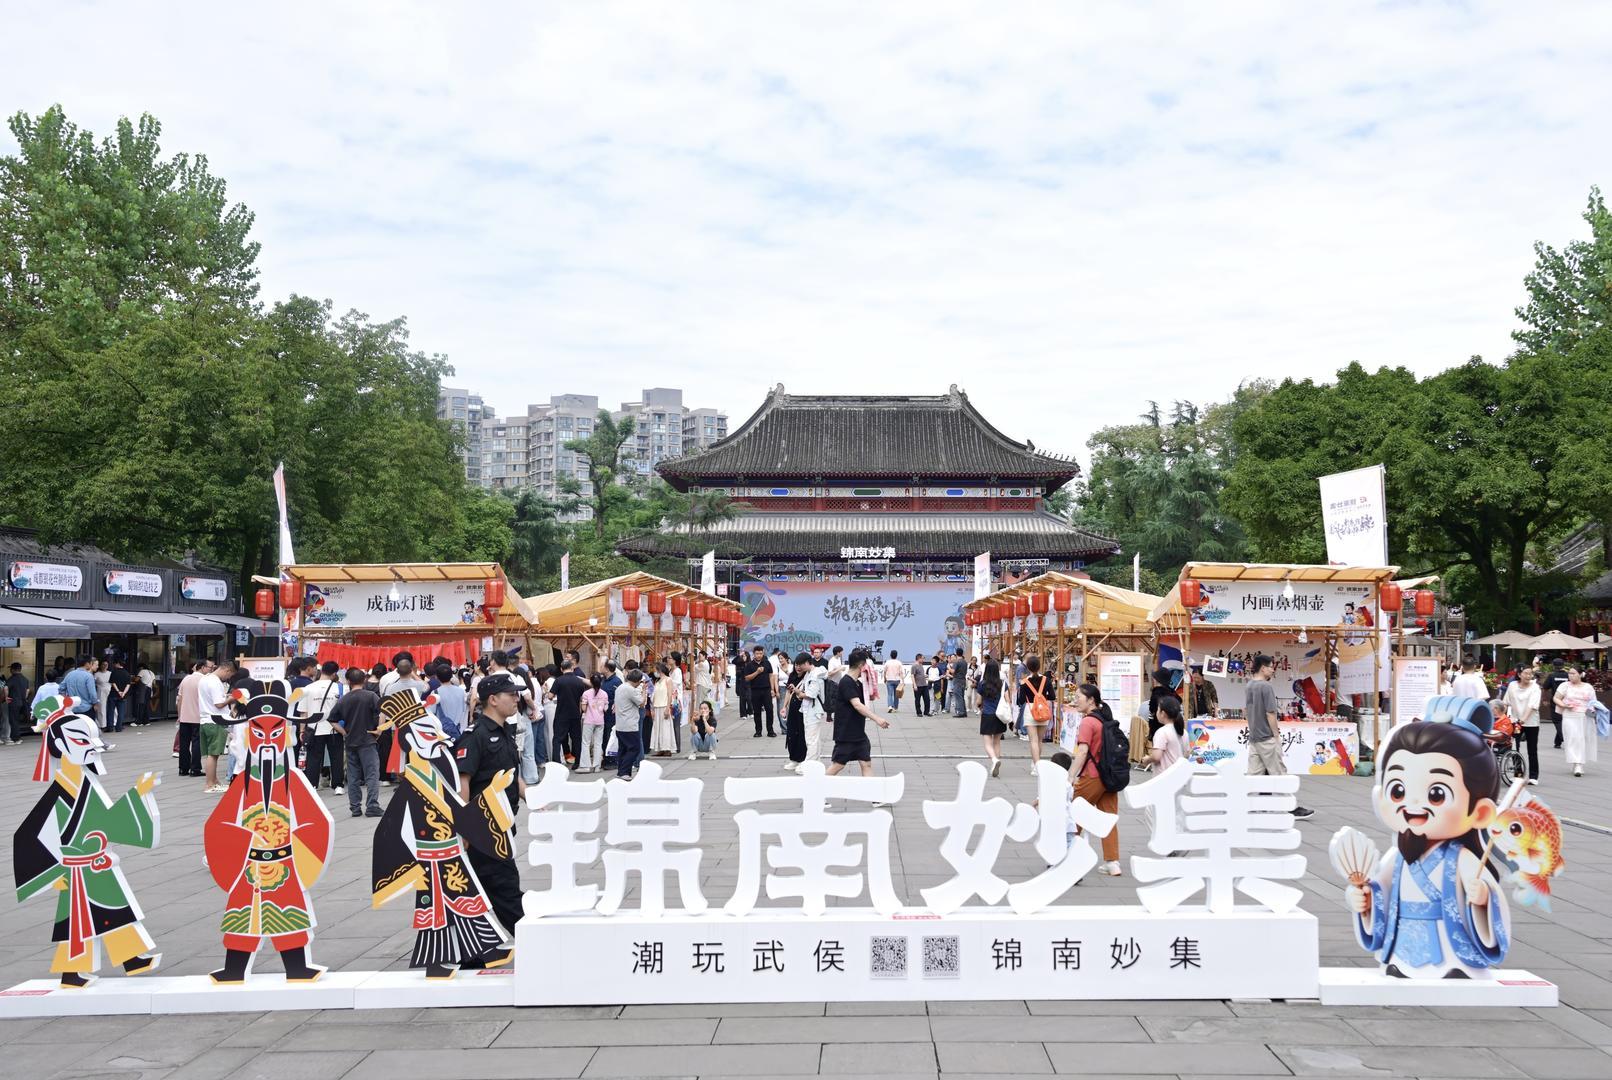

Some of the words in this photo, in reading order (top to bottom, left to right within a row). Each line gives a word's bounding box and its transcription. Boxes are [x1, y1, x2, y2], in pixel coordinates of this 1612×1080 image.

[840, 547, 896, 559] 锦南妙集
[366, 594, 435, 612] 成都灯谜
[1241, 594, 1324, 611] 内画鼻烟壶
[765, 633, 821, 643] ChaoWan
[521, 759, 1305, 918] 锦南妙集
[631, 940, 846, 974] 潮玩武侯
[992, 938, 1202, 971] 锦南妙集
